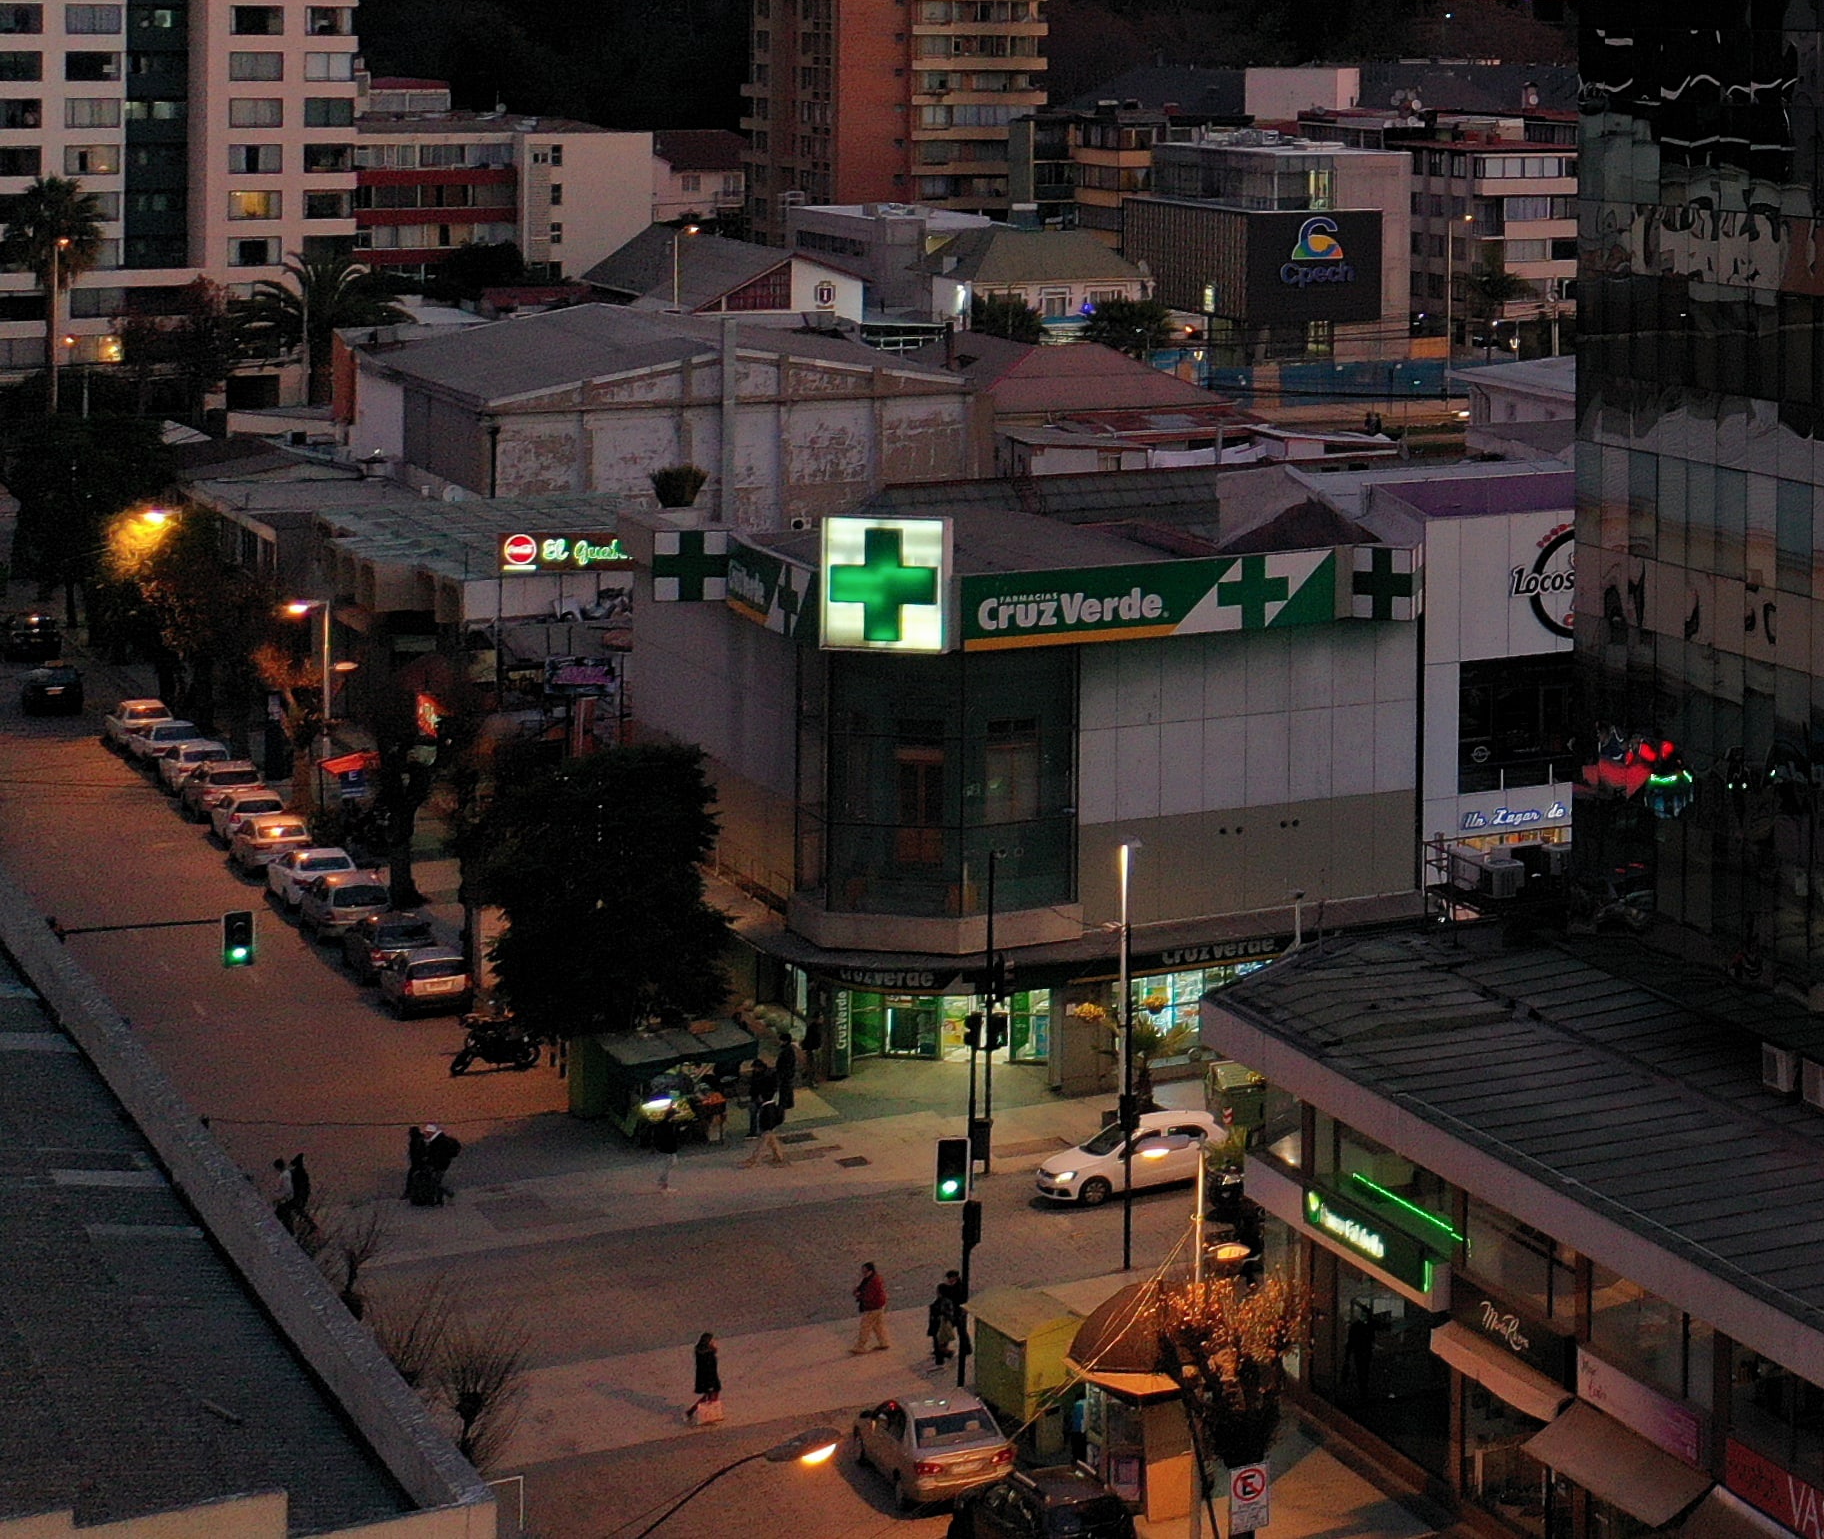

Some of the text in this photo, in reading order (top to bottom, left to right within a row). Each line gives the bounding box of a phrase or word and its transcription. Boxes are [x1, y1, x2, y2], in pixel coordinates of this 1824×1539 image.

[1280, 262, 1357, 288] Cpech
[542, 538, 569, 560] El
[1000, 591, 1058, 603] FARMACIAS
[978, 597, 1058, 631] Cruz
